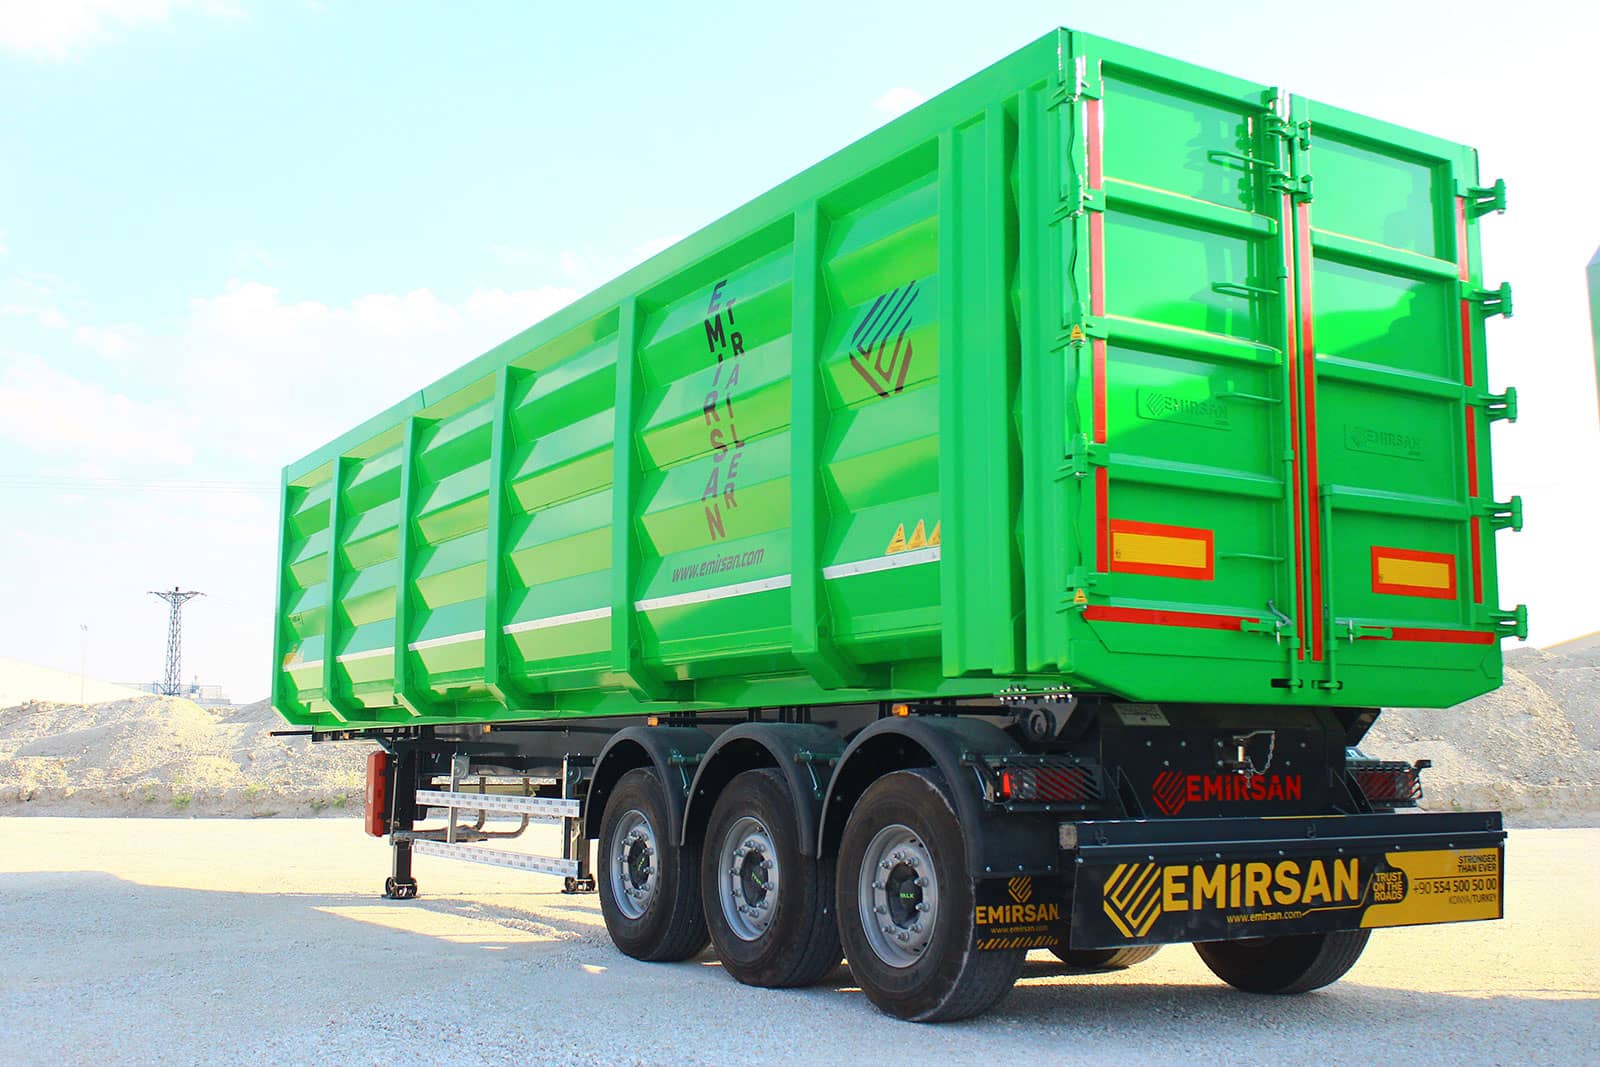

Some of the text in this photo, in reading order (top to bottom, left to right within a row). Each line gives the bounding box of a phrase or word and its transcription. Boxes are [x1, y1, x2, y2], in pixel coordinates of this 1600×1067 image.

[1457, 854, 1497, 864] STRONGER
[1457, 863, 1497, 873] THAN EVER
[1376, 872, 1403, 882] TRUST
[1373, 881, 1403, 892] ON THE
[1413, 878, 1497, 895] +90 554 500 50 00
[1374, 891, 1404, 901] ROADS
[1226, 910, 1303, 923] www.emirsan.com
